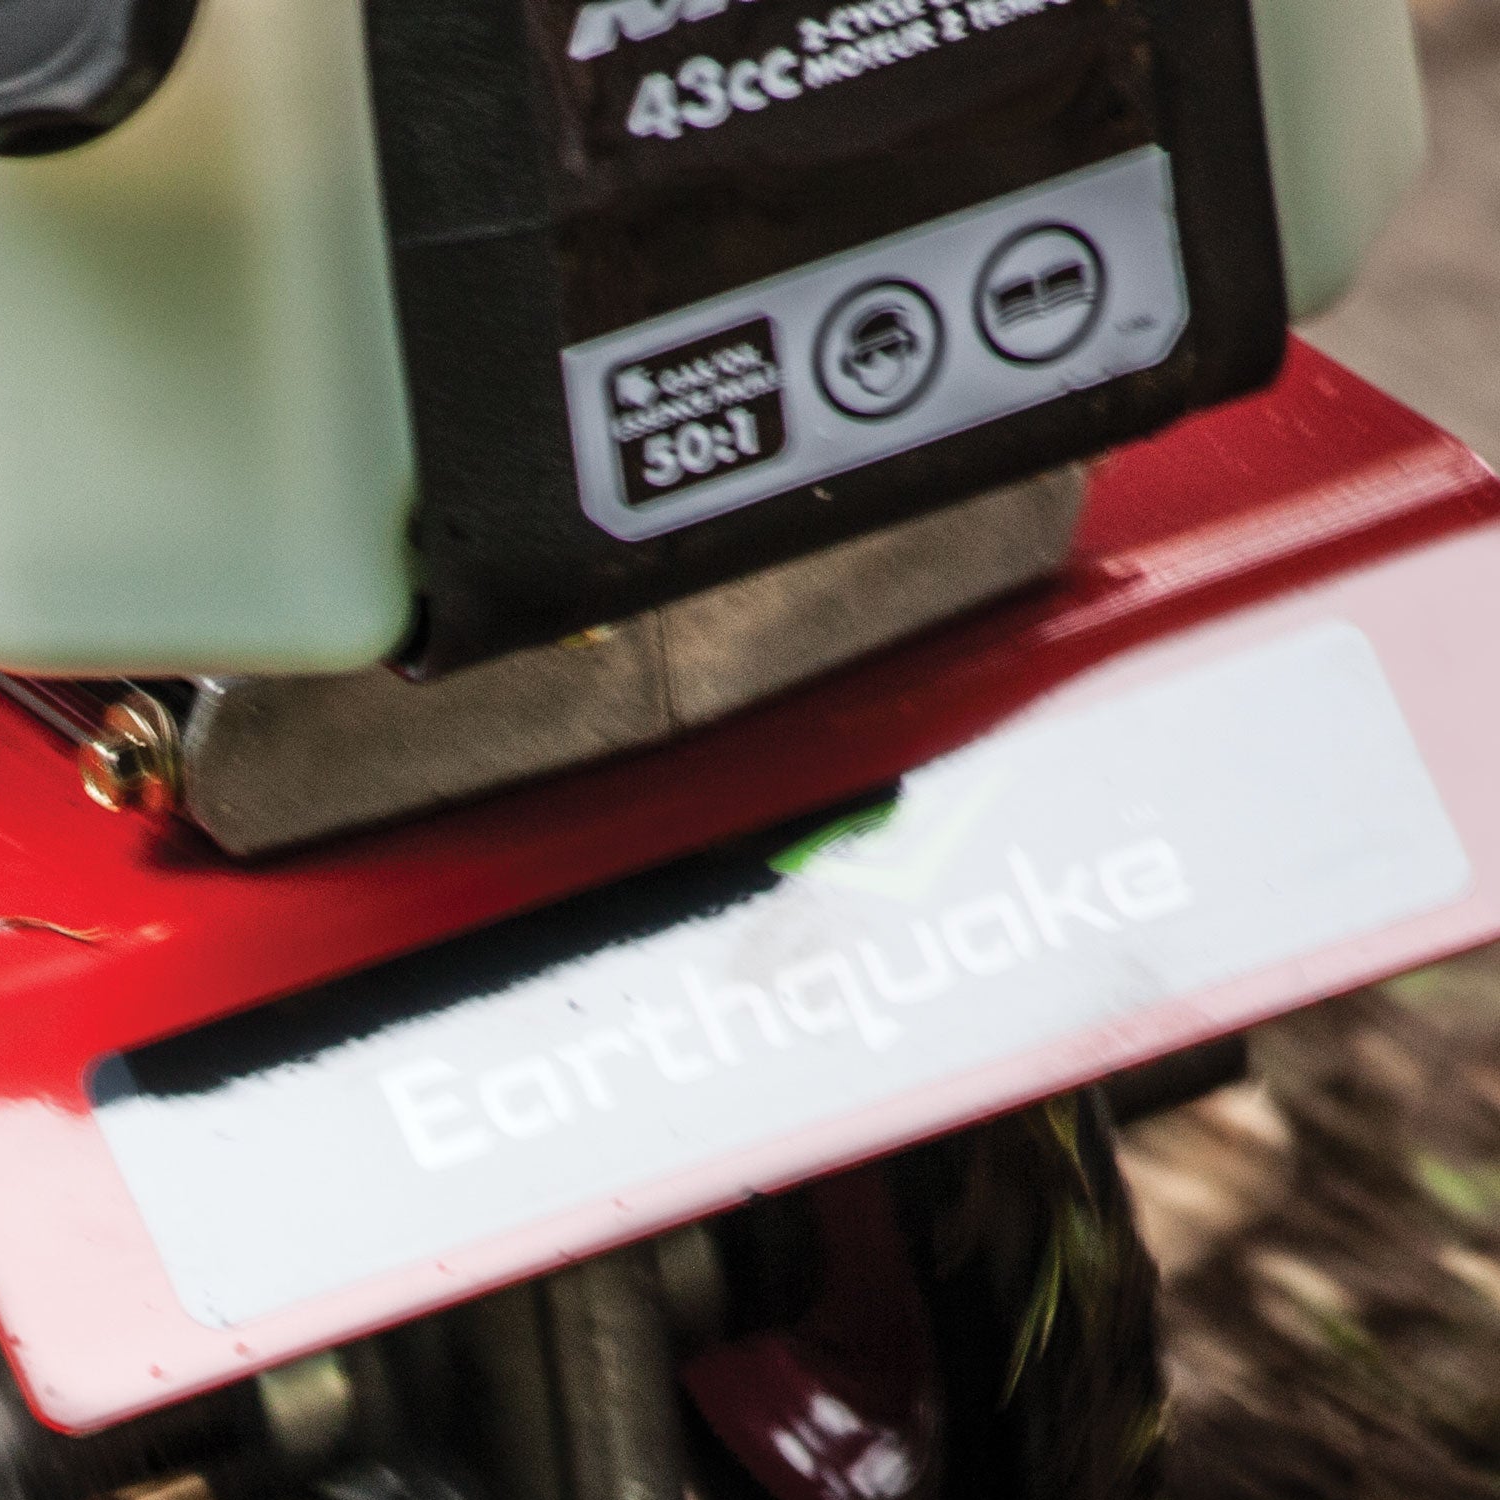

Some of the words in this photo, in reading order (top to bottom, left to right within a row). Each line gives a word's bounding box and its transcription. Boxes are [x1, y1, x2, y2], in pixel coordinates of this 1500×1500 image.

[627, 48, 802, 139] 43cc
[643, 406, 760, 487] 50:1
[379, 836, 1194, 1171] Earthquake
